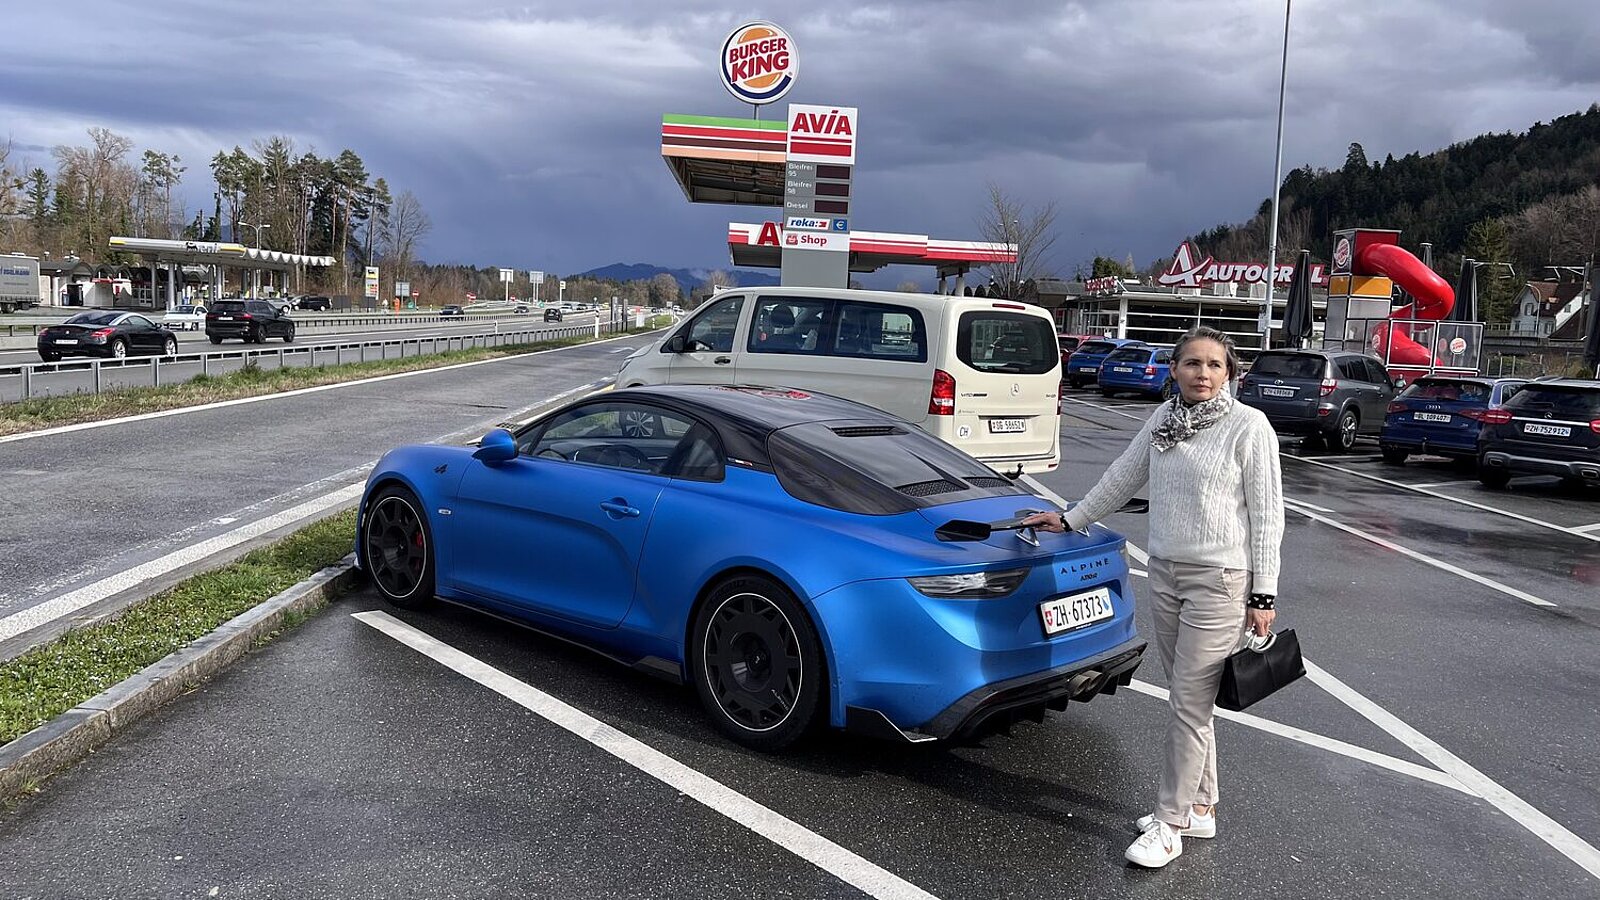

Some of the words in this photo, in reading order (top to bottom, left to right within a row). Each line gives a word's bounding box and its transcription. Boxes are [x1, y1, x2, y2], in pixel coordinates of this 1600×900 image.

[729, 38, 787, 63] BURGER
[732, 51, 789, 82] KING
[786, 201, 808, 209] Diesel
[800, 235, 827, 246] Shop
[1060, 558, 1110, 575] ALPINE
